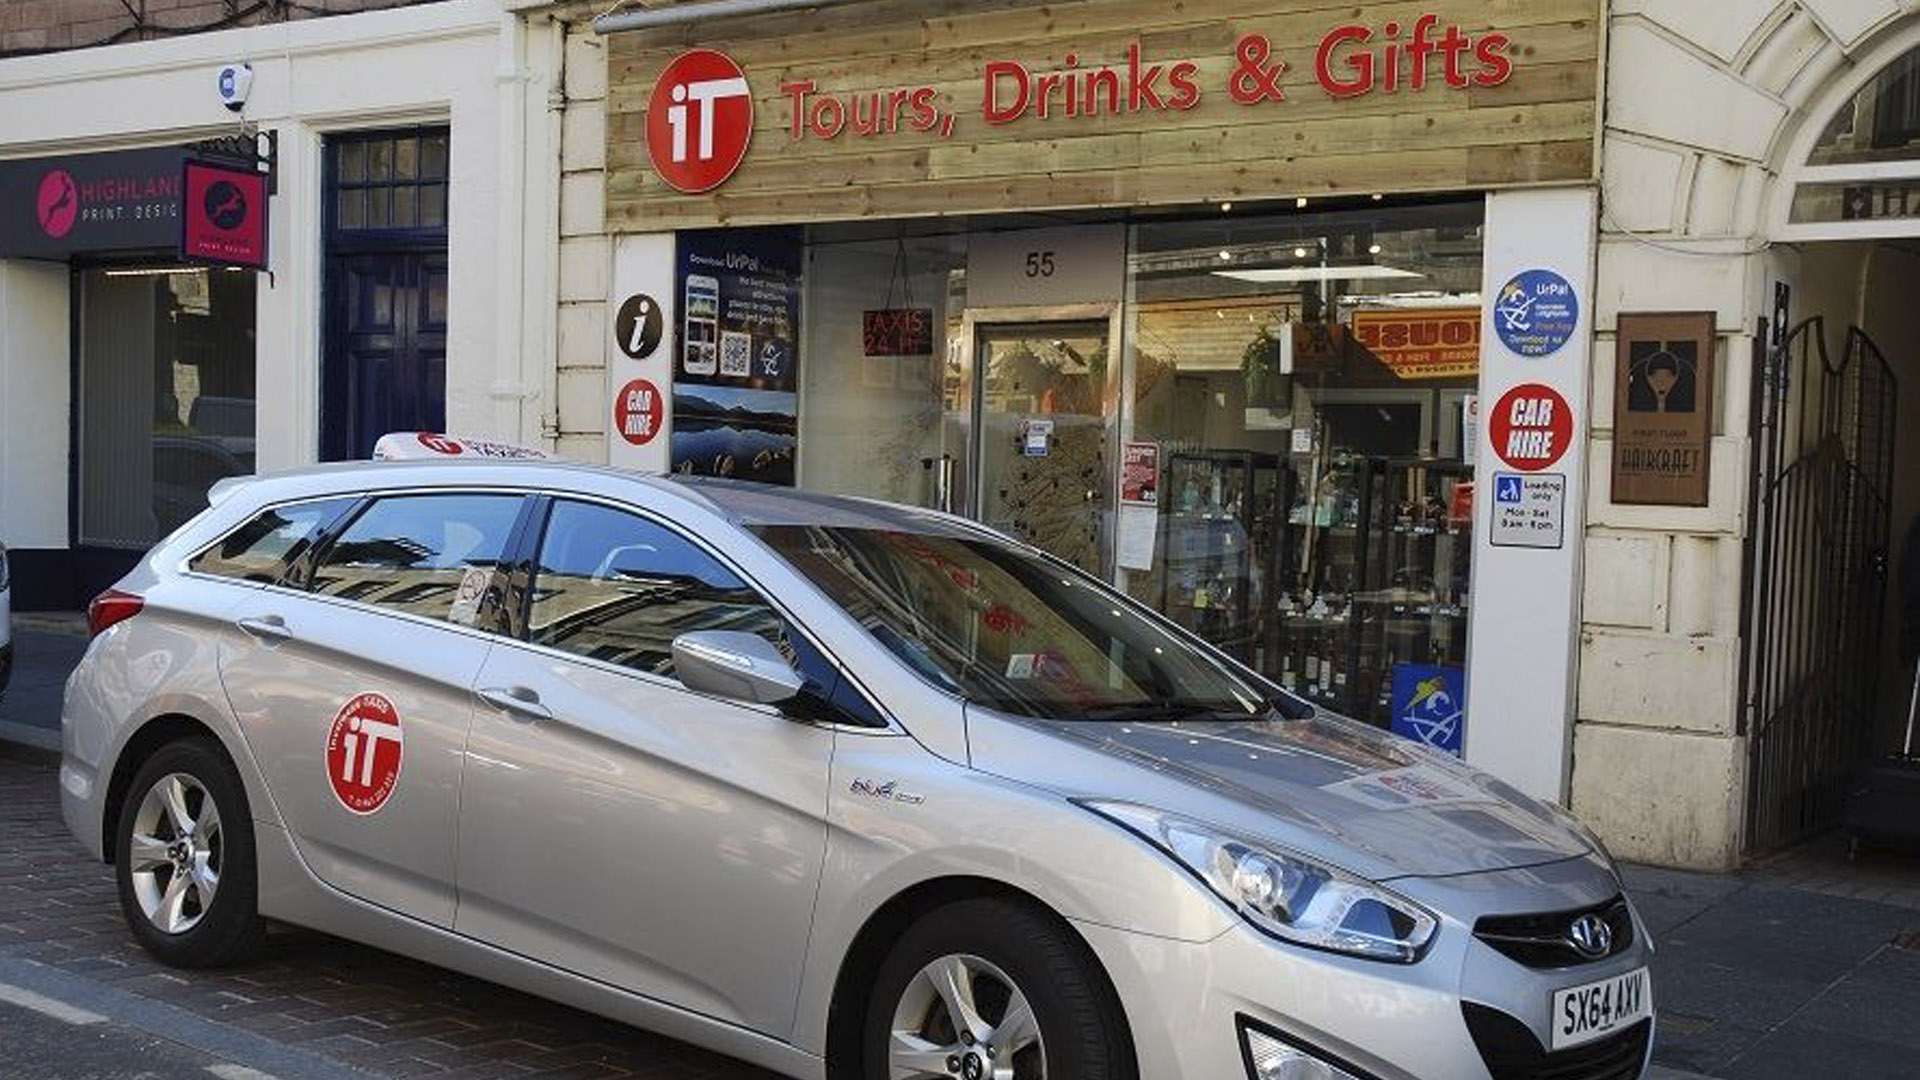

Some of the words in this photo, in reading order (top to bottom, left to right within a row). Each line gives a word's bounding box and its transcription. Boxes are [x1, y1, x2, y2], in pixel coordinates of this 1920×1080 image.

[781, 79, 955, 140] Tours,
[983, 42, 1201, 124] Drinks
[1228, 32, 1288, 105] &
[1315, 14, 1513, 97] Gifts
[136, 203, 177, 219] DESIG
[1026, 252, 1055, 278] 55
[1536, 282, 1568, 297] UrPal
[627, 389, 652, 411] CAR
[1509, 397, 1553, 427] CAR
[624, 413, 653, 436] HIRE
[1505, 429, 1554, 459] HIRE
[1620, 447, 1700, 473] HAIRCRAFT
[1524, 480, 1561, 492] Loading
[1530, 492, 1552, 502] only
[1563, 983, 1612, 1036] SX64
[1614, 971, 1643, 1020] AXV
